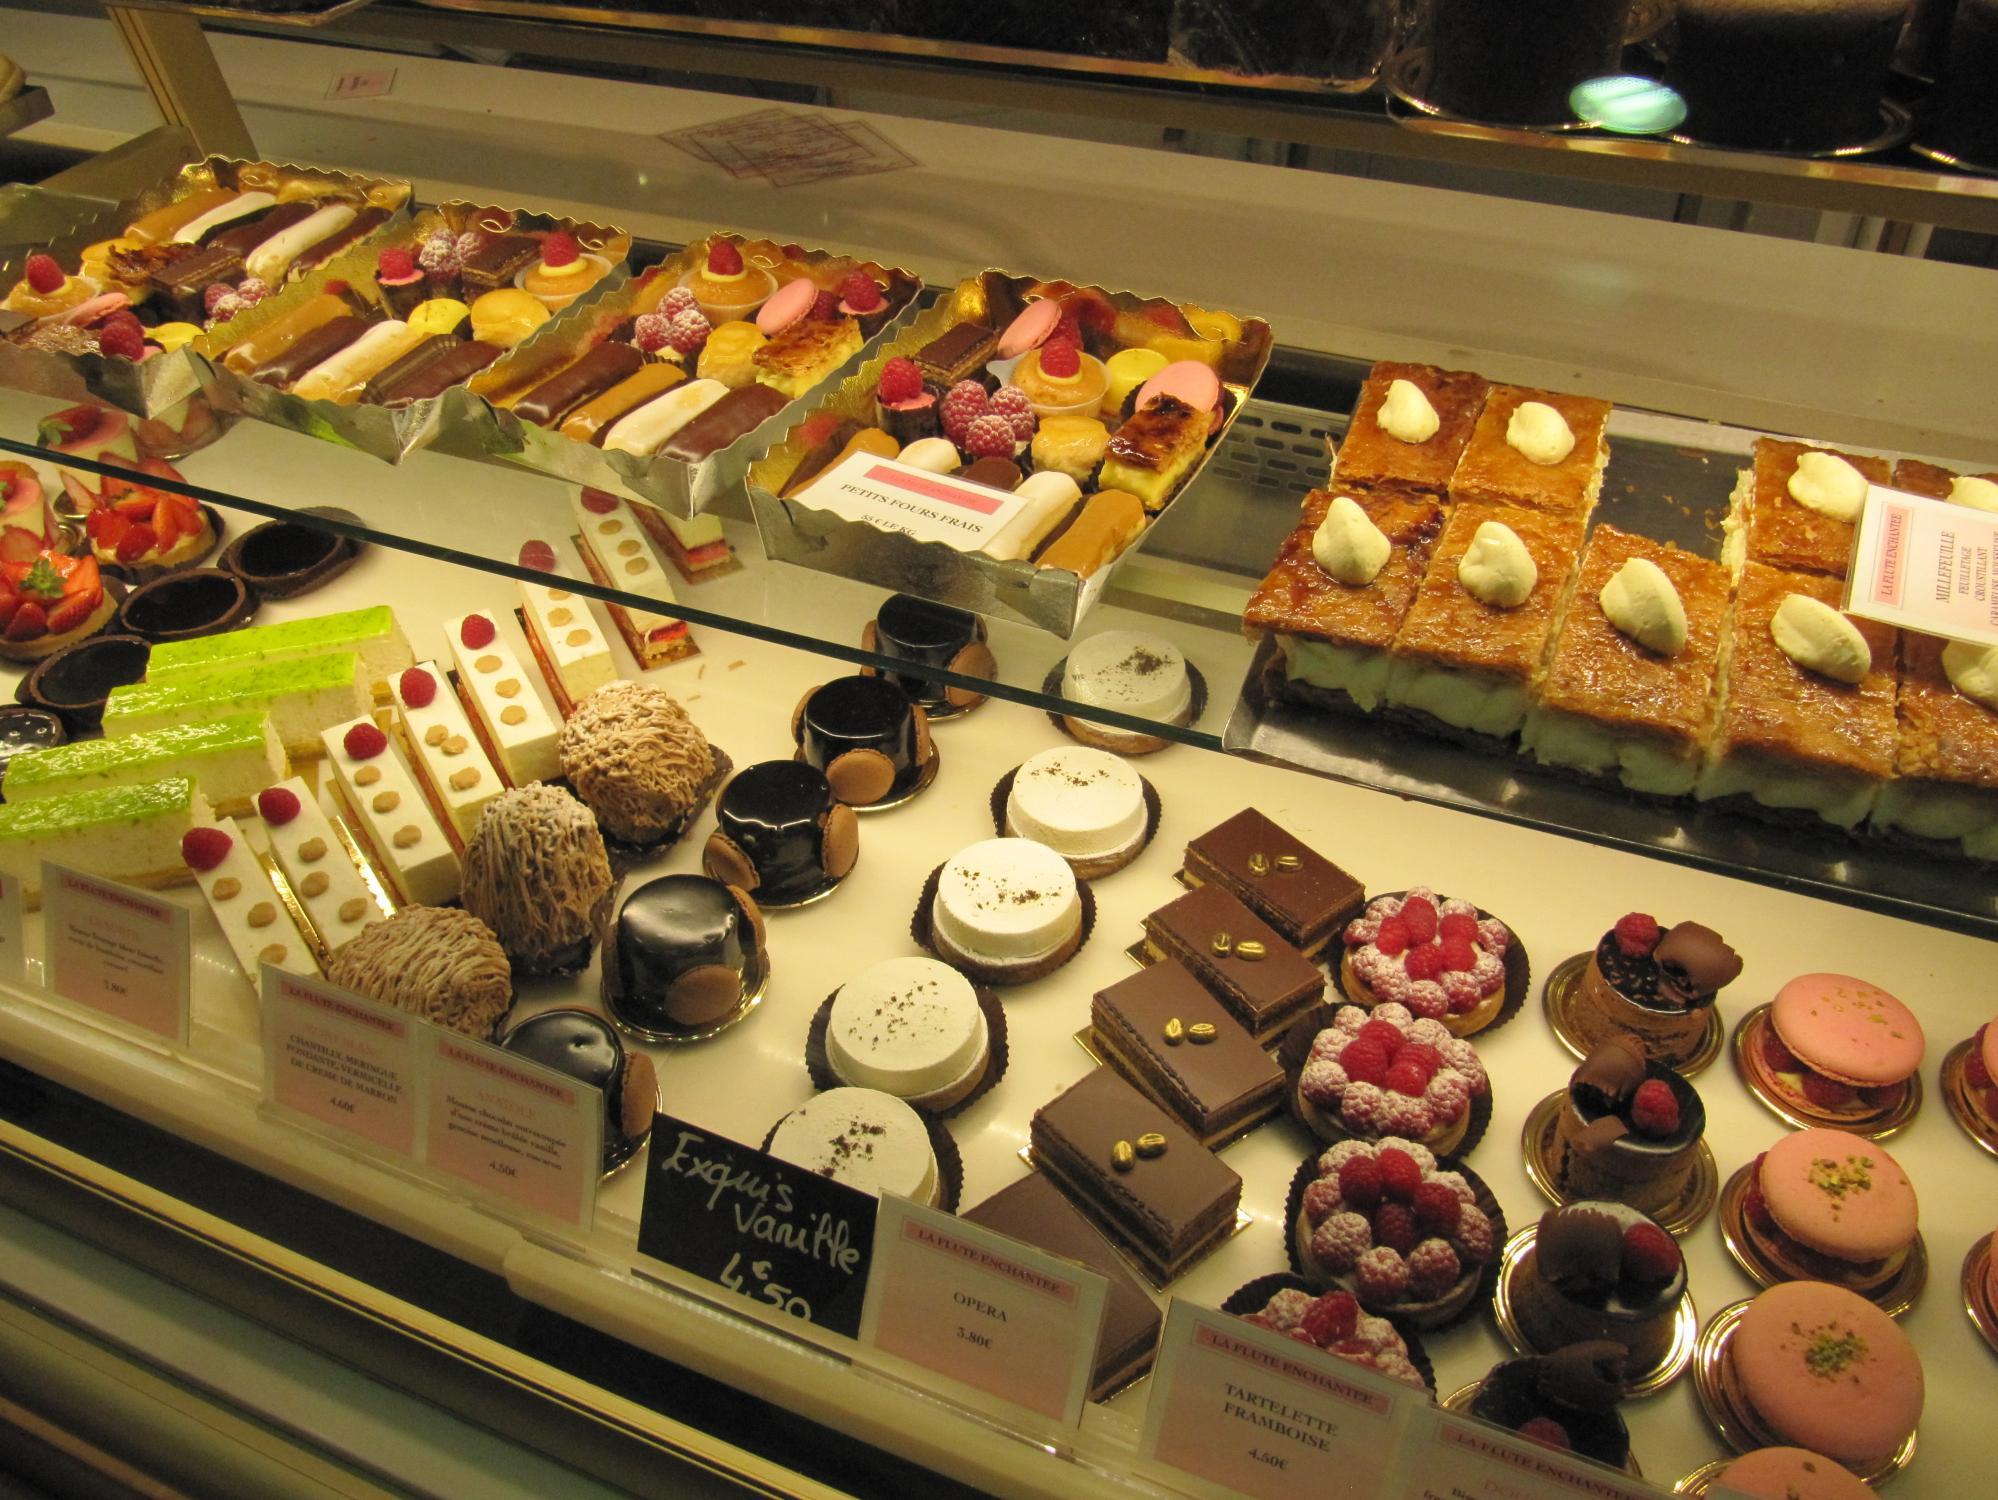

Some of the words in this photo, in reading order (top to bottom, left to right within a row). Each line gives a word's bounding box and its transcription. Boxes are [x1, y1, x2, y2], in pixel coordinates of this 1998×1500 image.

[841, 484, 888, 504] PETITS
[890, 499, 940, 520] FOURS
[940, 515, 983, 533] FRAIS
[1886, 514, 1902, 558] ENCHANTEE
[1881, 584, 1893, 596] LA
[1882, 558, 1896, 585] FLUTE
[1936, 530, 1954, 603] MILLEFEUILLE
[1958, 546, 1972, 596] FEUILLETAGE
[1974, 546, 1988, 602] CROUSTILLANT
[290, 1056, 303, 1068] DE
[340, 1076, 354, 1088] DE
[355, 1082, 398, 1104] MARRON
[340, 1064, 403, 1094] VERMICELLE
[345, 1054, 399, 1081] MERINGUE
[448, 1046, 462, 1059] LA
[464, 1052, 498, 1072] FLUTE
[488, 1160, 518, 1178] 4.50€
[661, 1131, 794, 1213] Exquis
[734, 1202, 862, 1275] Vanille
[918, 1230, 936, 1244] LA
[938, 1236, 976, 1259] FLUTE
[980, 1254, 1061, 1295] ENCHANTEE
[953, 1291, 1008, 1322] OPERA
[1212, 1334, 1230, 1351] LA
[1233, 1343, 1279, 1370] FLUTE
[1282, 1362, 1374, 1406] ENCHANTEE
[1224, 1383, 1340, 1437] TARTELETTE
[1224, 1402, 1332, 1453] FRAMBOISE
[1248, 1447, 1290, 1472] 4.50€
[1457, 1433, 1476, 1448] LA
[1481, 1442, 1532, 1467] FLUTE
